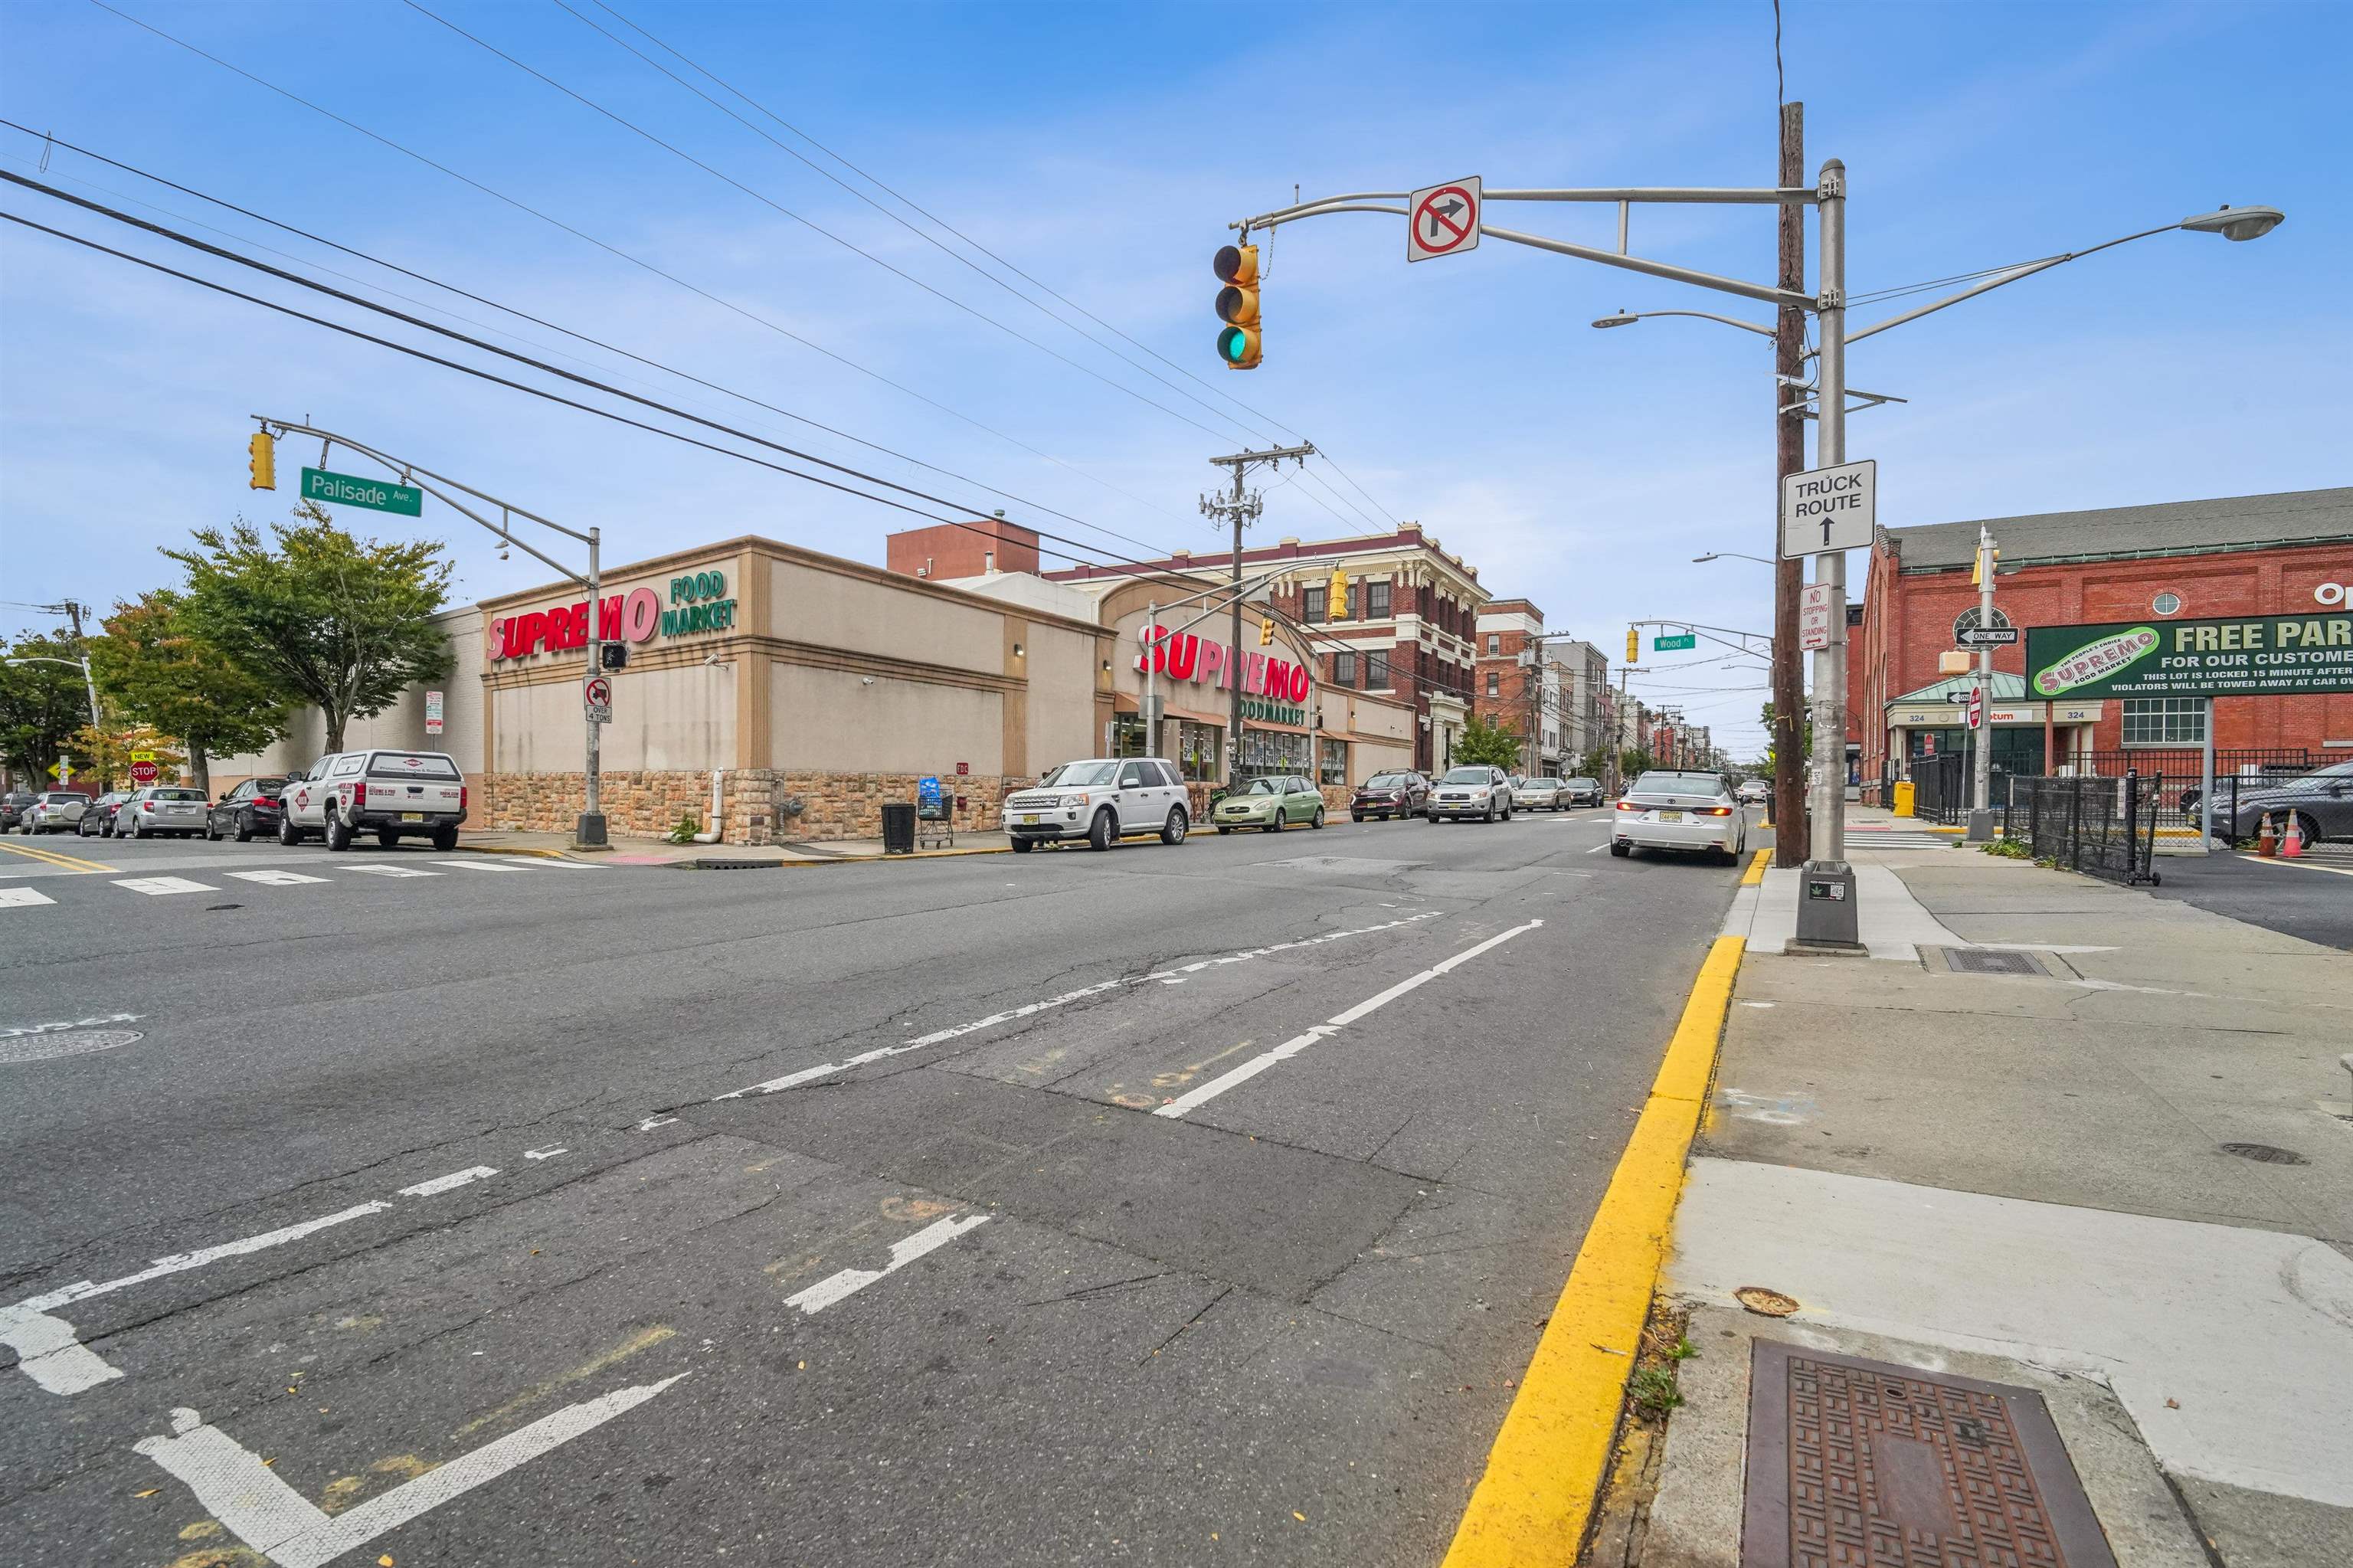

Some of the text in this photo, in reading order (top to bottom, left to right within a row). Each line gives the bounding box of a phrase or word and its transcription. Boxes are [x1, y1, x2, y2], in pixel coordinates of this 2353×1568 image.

[312, 475, 413, 505] Palisade Ave.
[1795, 473, 1863, 498] TRUCK
[1796, 493, 1861, 518] ROUTE
[670, 571, 728, 604] FOOD
[1810, 590, 1821, 604] NO
[661, 599, 737, 637] MARKET
[1802, 604, 1828, 617] STOPPING
[1811, 617, 1818, 625] OR
[486, 587, 660, 660] SUPREMO
[1802, 626, 1827, 637] STANDING
[2175, 620, 2352, 652] FREE PAR
[1661, 638, 1681, 648] Wood
[2060, 659, 2070, 668] THE
[2099, 638, 2122, 649] CHOICE
[1133, 624, 1310, 703] SUPREMO
[2039, 632, 2155, 692] SUPREMO
[2074, 656, 2132, 685] FOOD MARKET
[2162, 656, 2200, 668] FOR
[2206, 654, 2249, 666] OUR
[2206, 670, 2248, 679] LOCKED
[2269, 668, 2314, 676] MINUTE
[2112, 683, 2168, 691] VIOLATORS
[2218, 679, 2256, 688] TOWED
[2260, 679, 2292, 687] AWAY
[596, 714, 610, 722] TONS
[1239, 699, 1306, 725] OODMARKET
[133, 767, 155, 776] STOP
